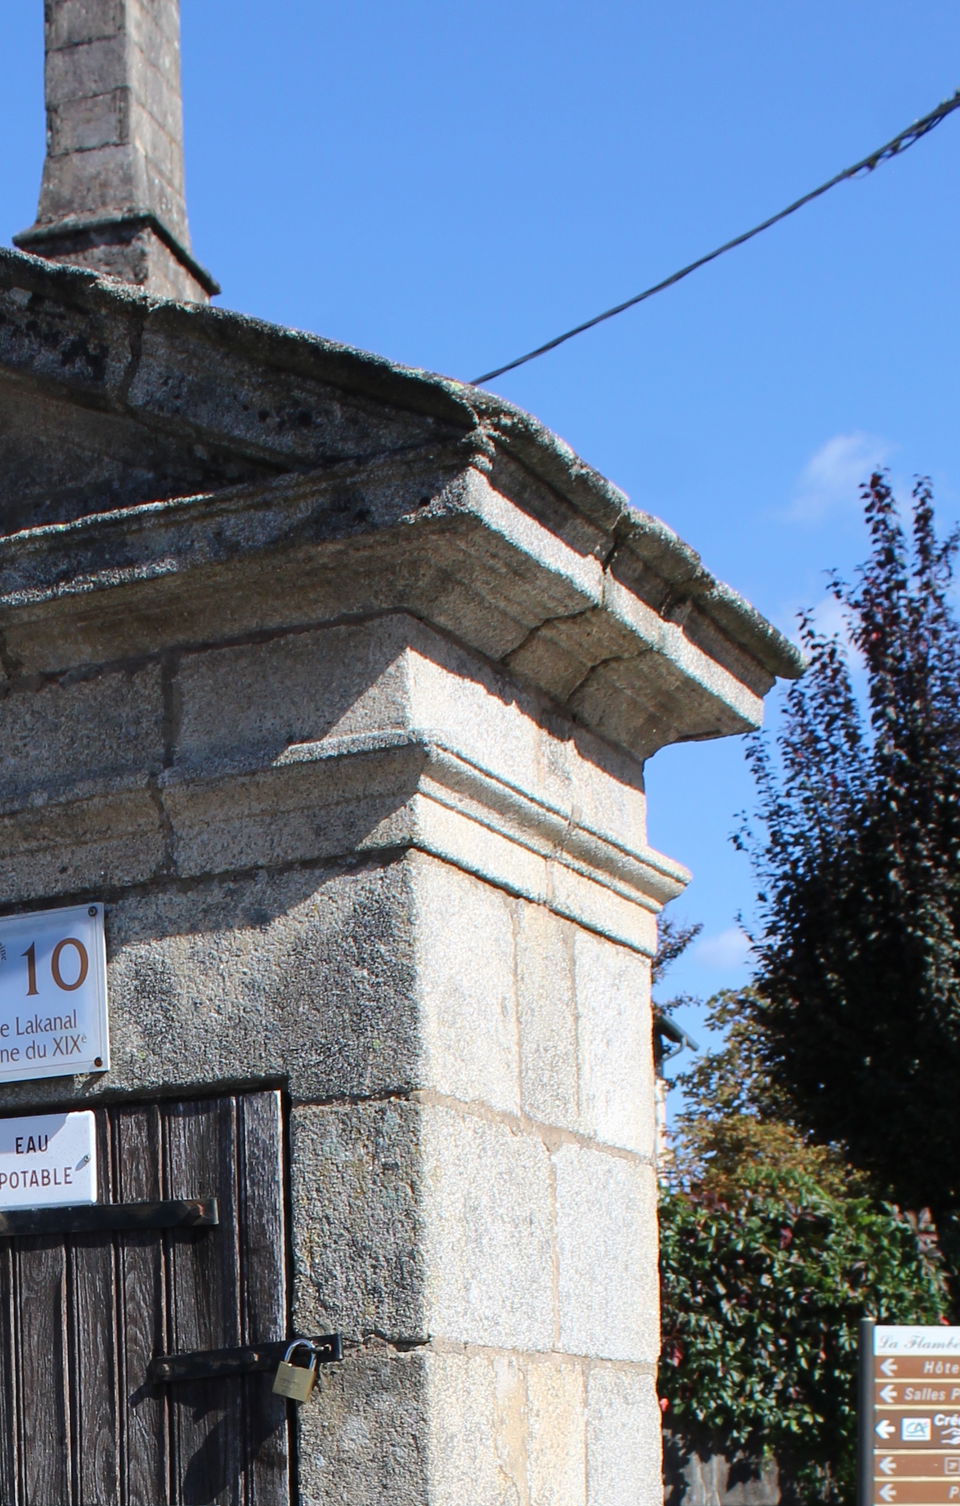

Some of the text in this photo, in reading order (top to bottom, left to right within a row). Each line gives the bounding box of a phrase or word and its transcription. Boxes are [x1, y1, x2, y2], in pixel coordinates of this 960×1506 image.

[21, 937, 88, 996] 10
[16, 1009, 78, 1035] Lakanal
[25, 1039, 47, 1059] du
[15, 1135, 49, 1155] EAU
[879, 1334, 899, 1349] La
[904, 1386, 946, 1401] Salles
